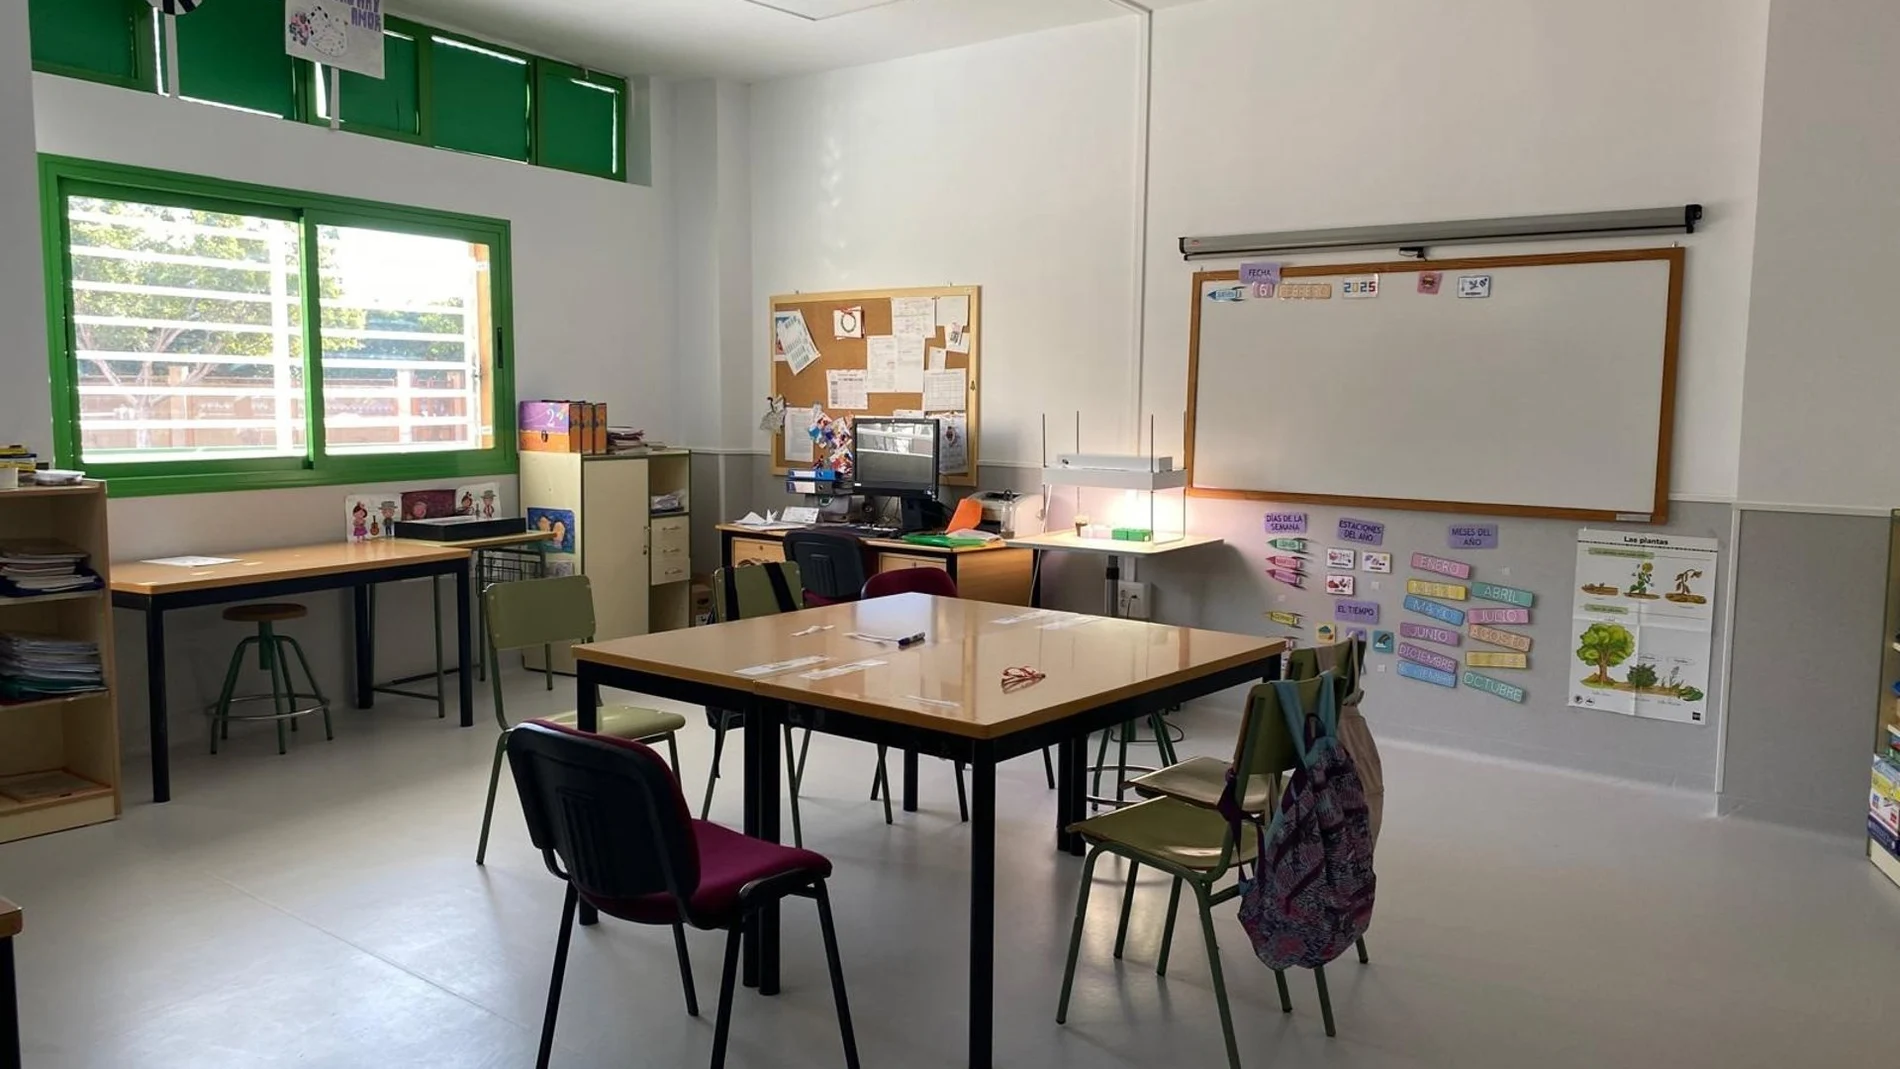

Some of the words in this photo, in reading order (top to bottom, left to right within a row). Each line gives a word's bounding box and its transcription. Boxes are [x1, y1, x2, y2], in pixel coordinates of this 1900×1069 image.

[1248, 268, 1271, 277] FECHA
[1259, 284, 1267, 296] 6
[1343, 281, 1376, 292] 2025
[547, 408, 556, 427] 2
[1266, 514, 1283, 523] DÍAS
[1283, 515, 1292, 523] DE
[1293, 515, 1302, 523] LA
[1271, 522, 1300, 531] SEMANA
[1339, 519, 1382, 534] ESTACIONES
[1451, 527, 1475, 537] MESES
[1477, 528, 1492, 537] DEL
[1344, 530, 1358, 539] DEL
[1624, 535, 1638, 544] Las
[1639, 536, 1669, 546] plantas
[1463, 536, 1482, 546] AÑO
[1420, 556, 1459, 574] ENERO
[1484, 586, 1519, 603] ABRIL
[1337, 605, 1347, 614] EL
[1347, 606, 1375, 617] TIEMPO
[1481, 609, 1518, 622] JULIO
[1411, 627, 1448, 642] JUNIO
[1399, 645, 1456, 672] DICIEMBRE
[1464, 672, 1523, 703] OCTUBRE
